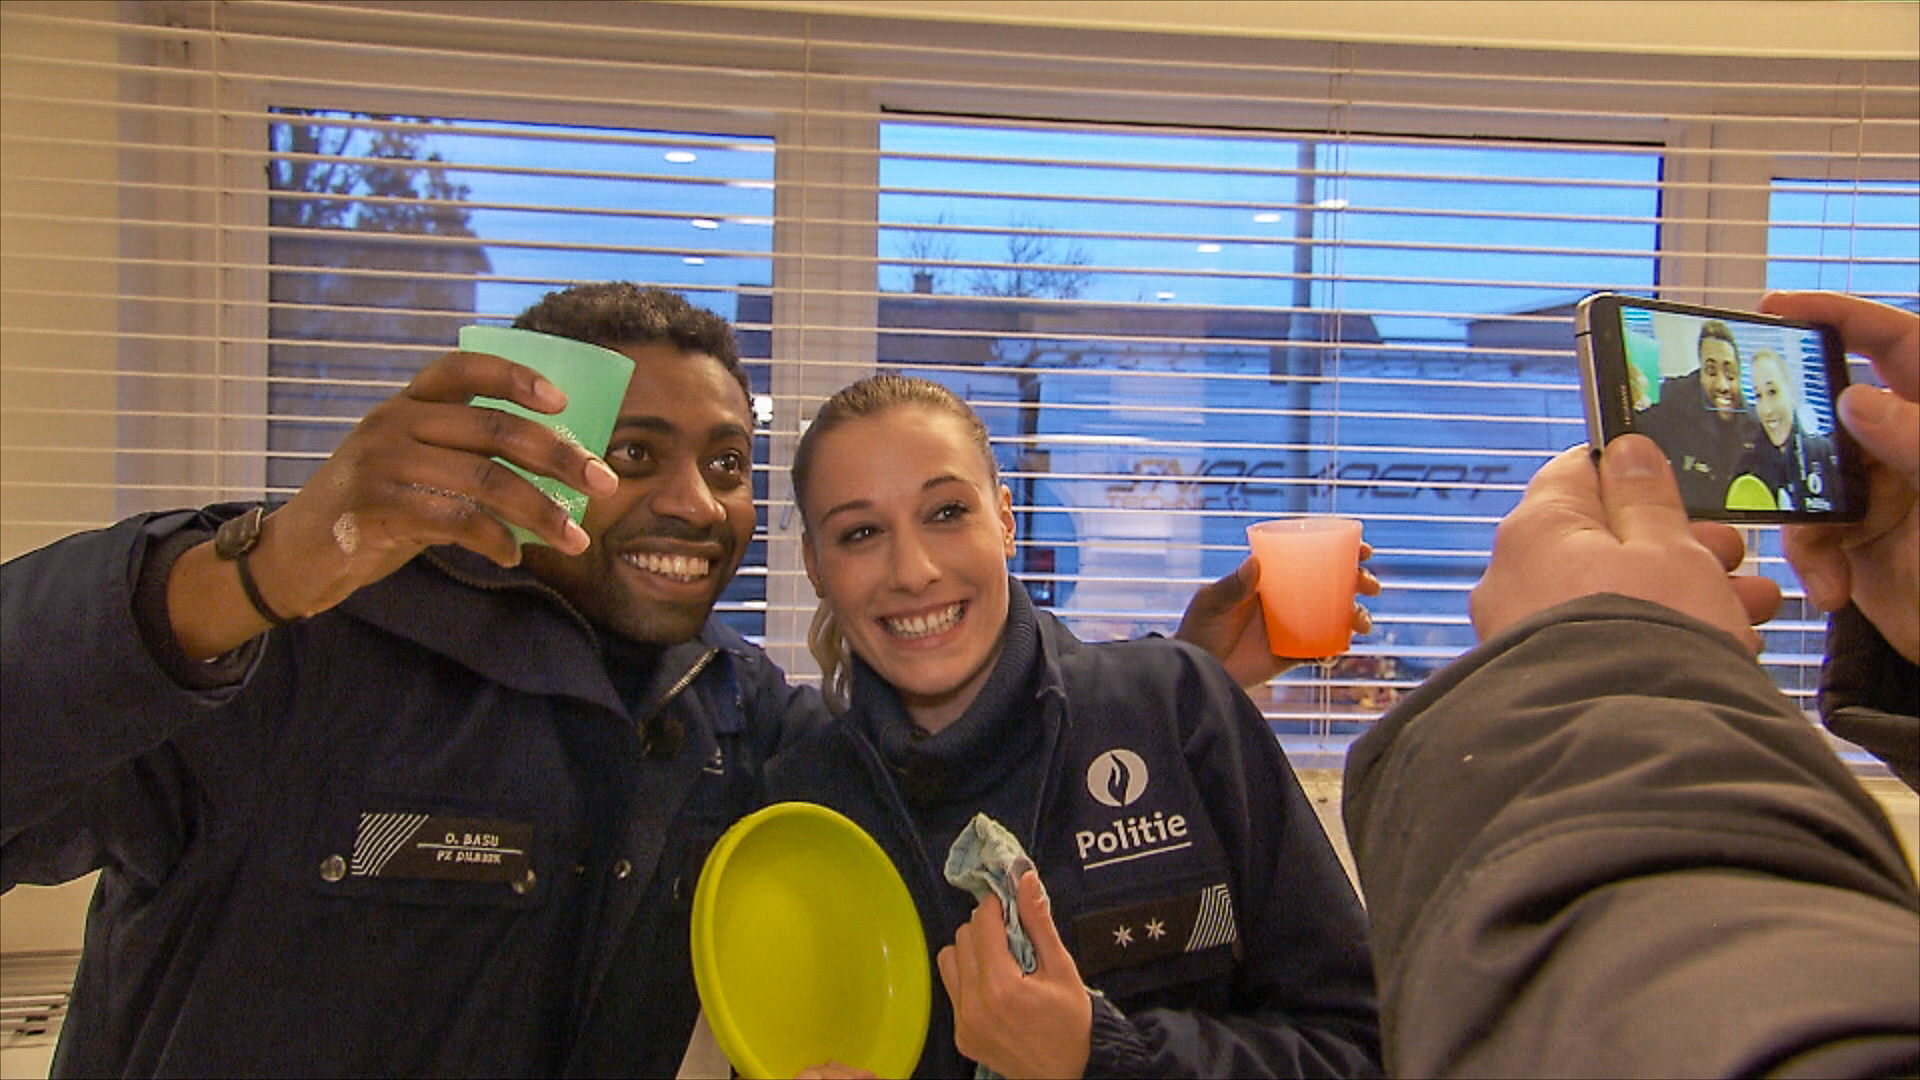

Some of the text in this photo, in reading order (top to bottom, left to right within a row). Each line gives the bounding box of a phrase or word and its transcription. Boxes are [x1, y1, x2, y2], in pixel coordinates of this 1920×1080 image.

[445, 832, 500, 847] O. BASU
[1075, 811, 1188, 859] Politie
